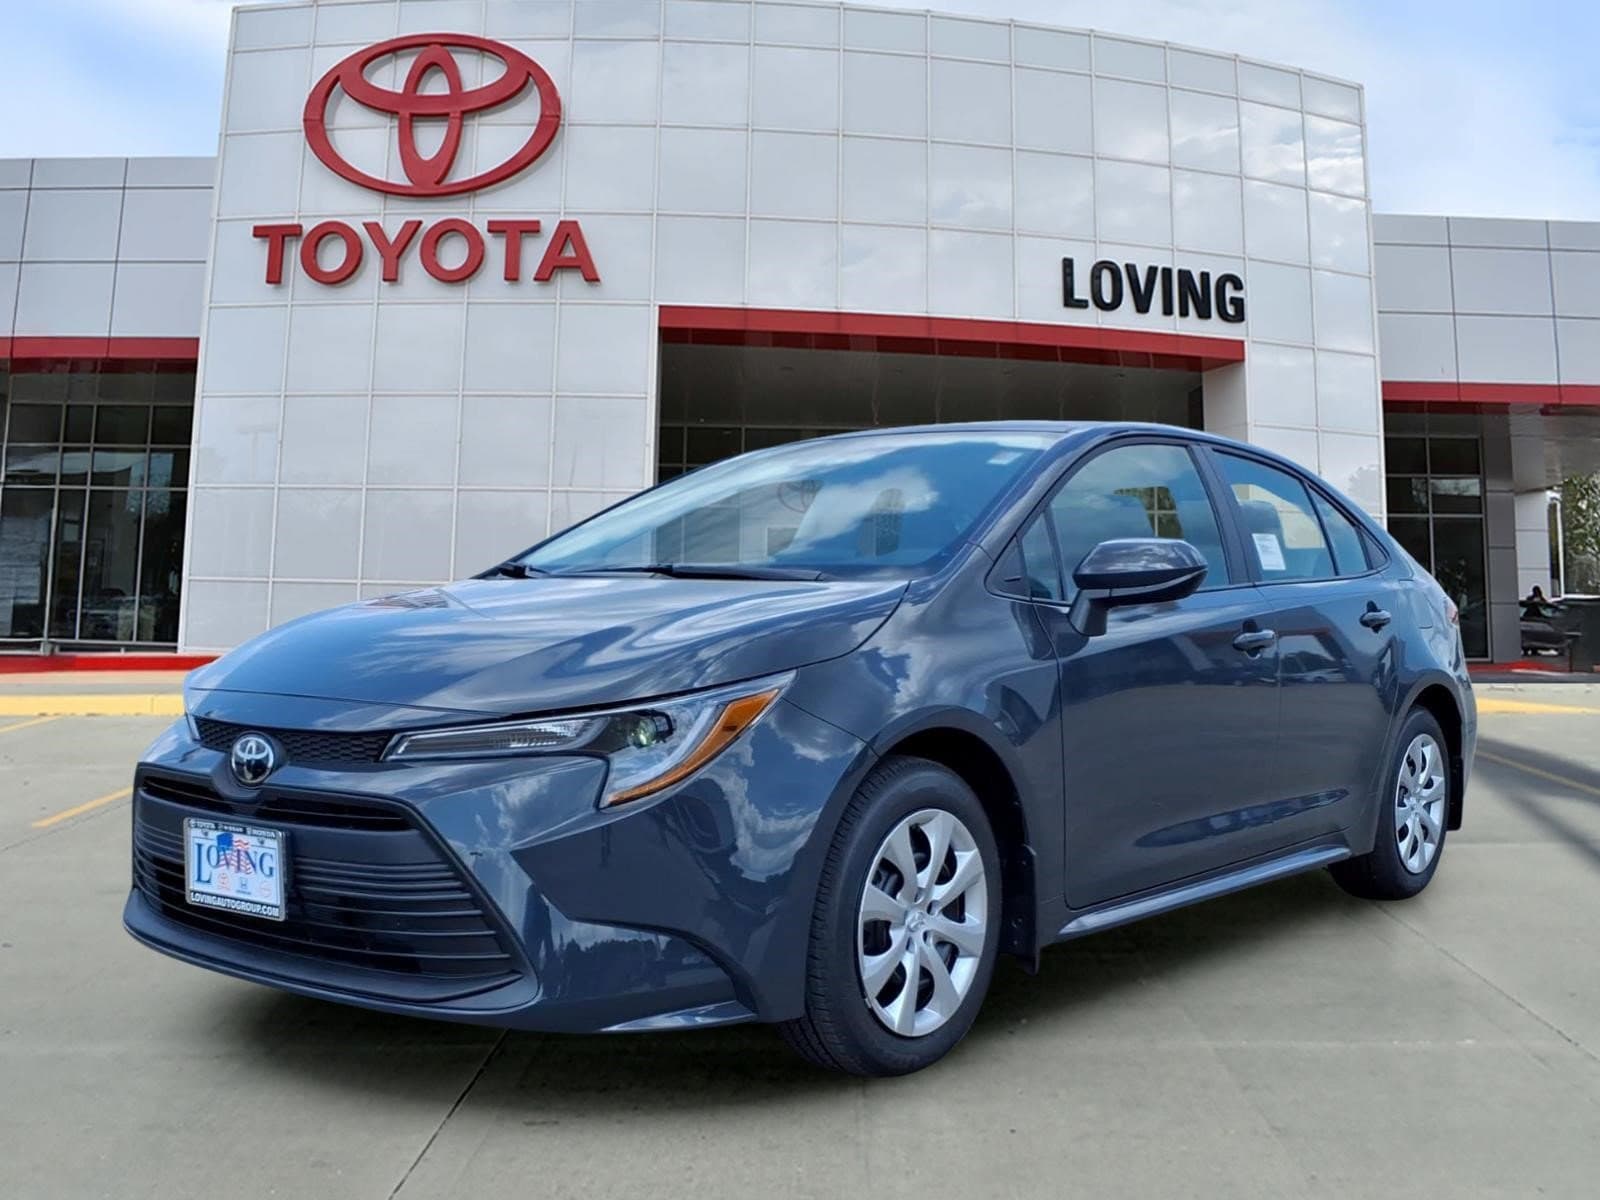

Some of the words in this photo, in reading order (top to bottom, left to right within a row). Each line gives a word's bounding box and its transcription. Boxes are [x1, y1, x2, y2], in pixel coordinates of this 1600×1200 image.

[252, 218, 601, 285] TOYOTA
[1062, 257, 1246, 324] LOVING
[194, 842, 275, 885] LOVING
[190, 892, 280, 917] LOVINGAUTOGROUP.COM
